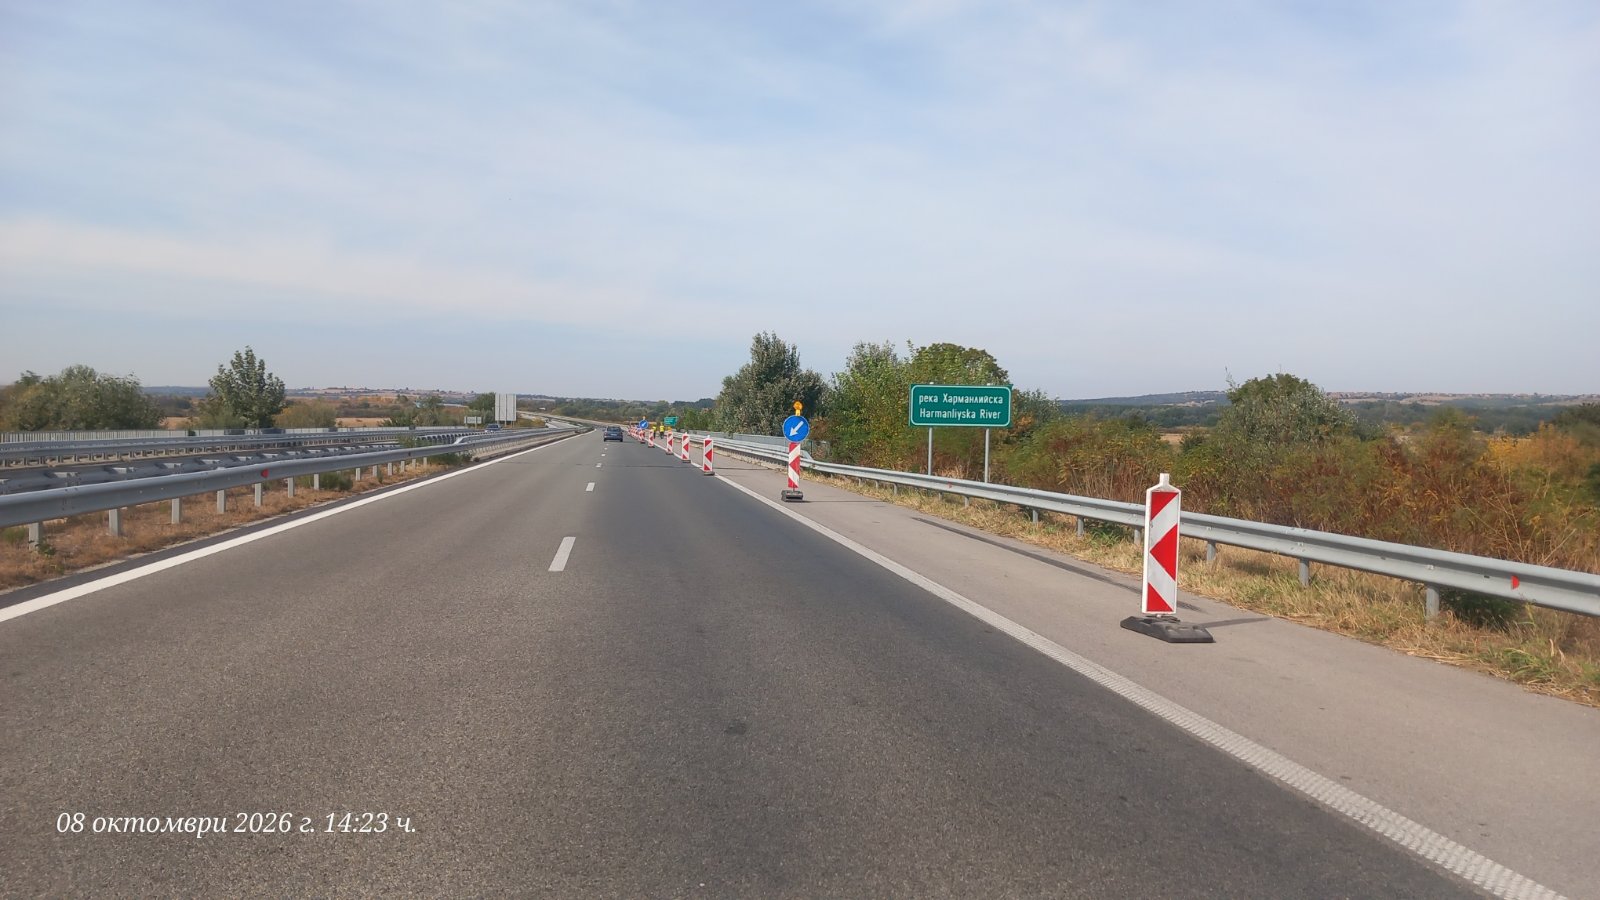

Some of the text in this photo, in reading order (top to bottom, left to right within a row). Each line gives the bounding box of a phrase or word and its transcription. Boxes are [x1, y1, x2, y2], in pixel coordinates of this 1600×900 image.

[919, 393, 1003, 405] река Харманлийска
[920, 408, 1001, 420] Harmanliyska River
